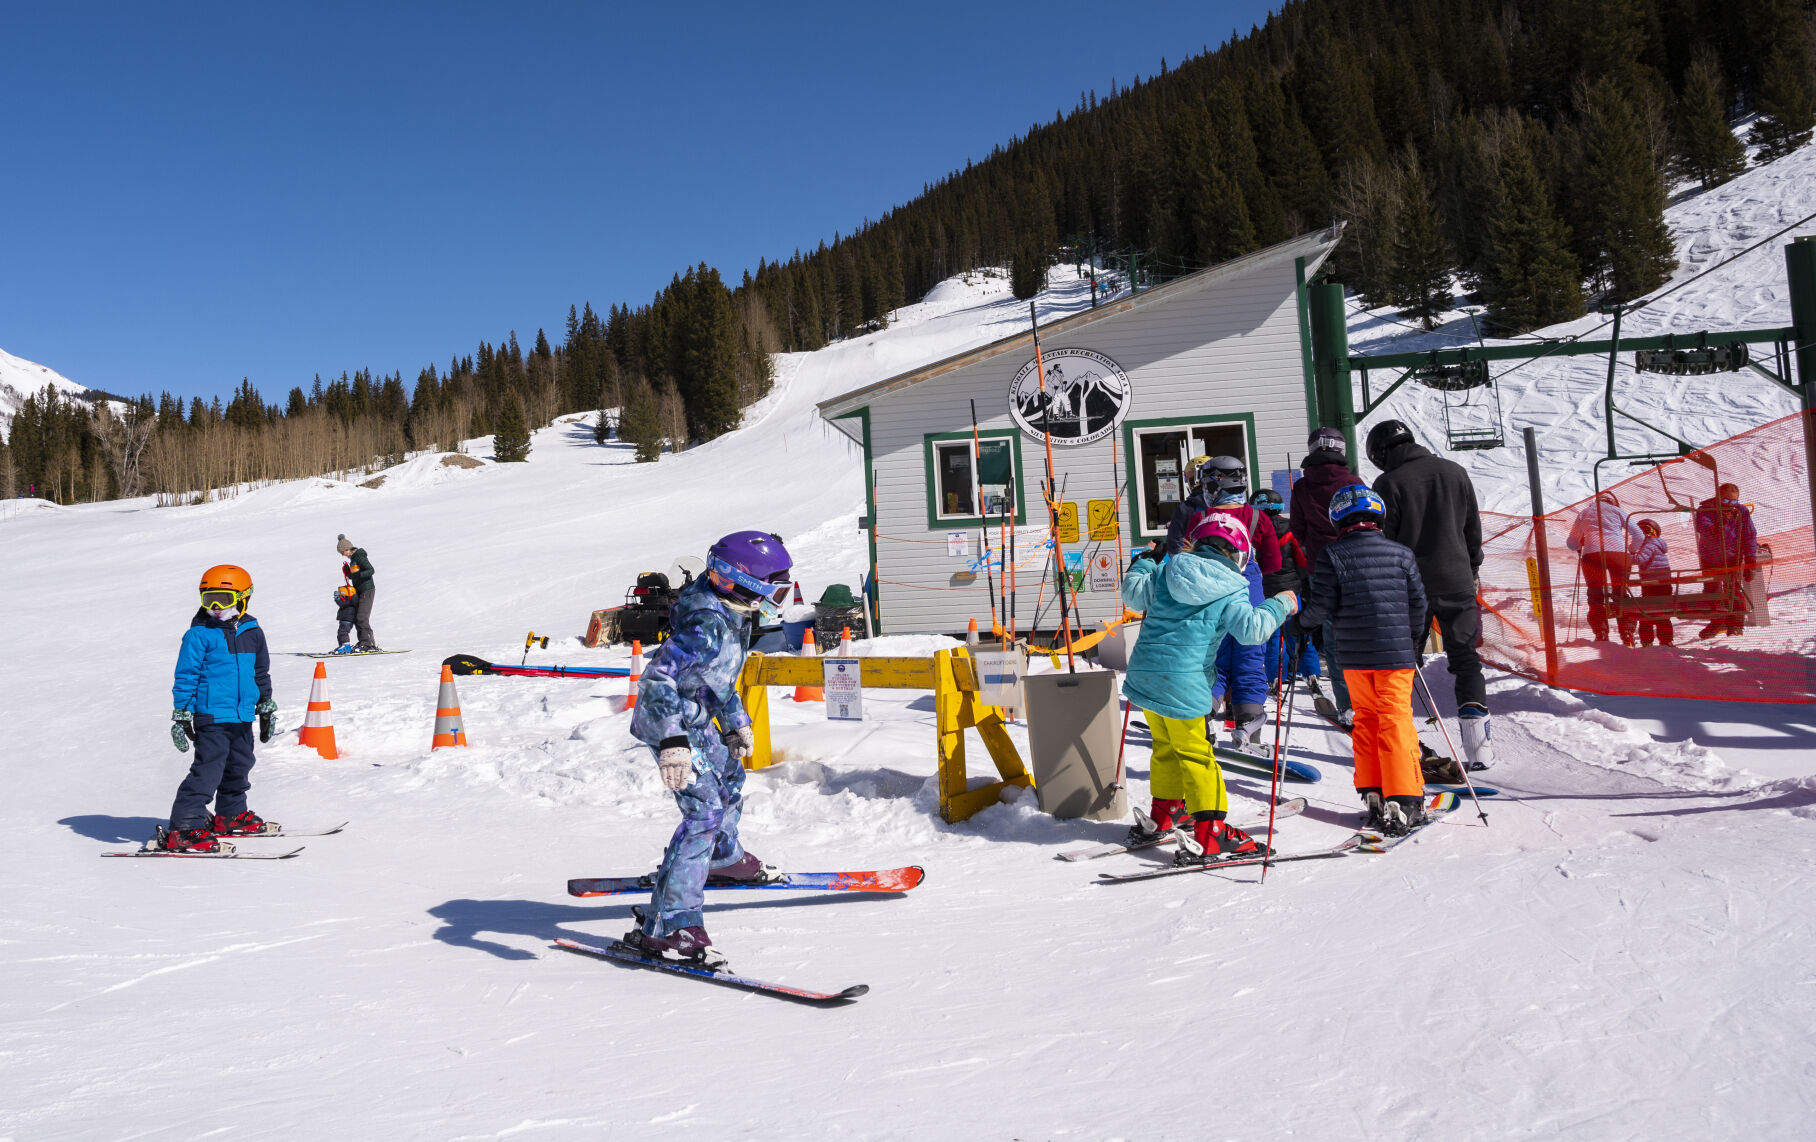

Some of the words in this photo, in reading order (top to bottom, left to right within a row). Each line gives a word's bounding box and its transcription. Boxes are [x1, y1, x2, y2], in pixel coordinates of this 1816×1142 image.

[1011, 366, 1031, 395] KENDALL
[1069, 349, 1116, 368] RECREATION
[1116, 370, 1129, 388] AREA
[1076, 425, 1114, 444] COLORADO
[737, 575, 763, 591] SMITH
